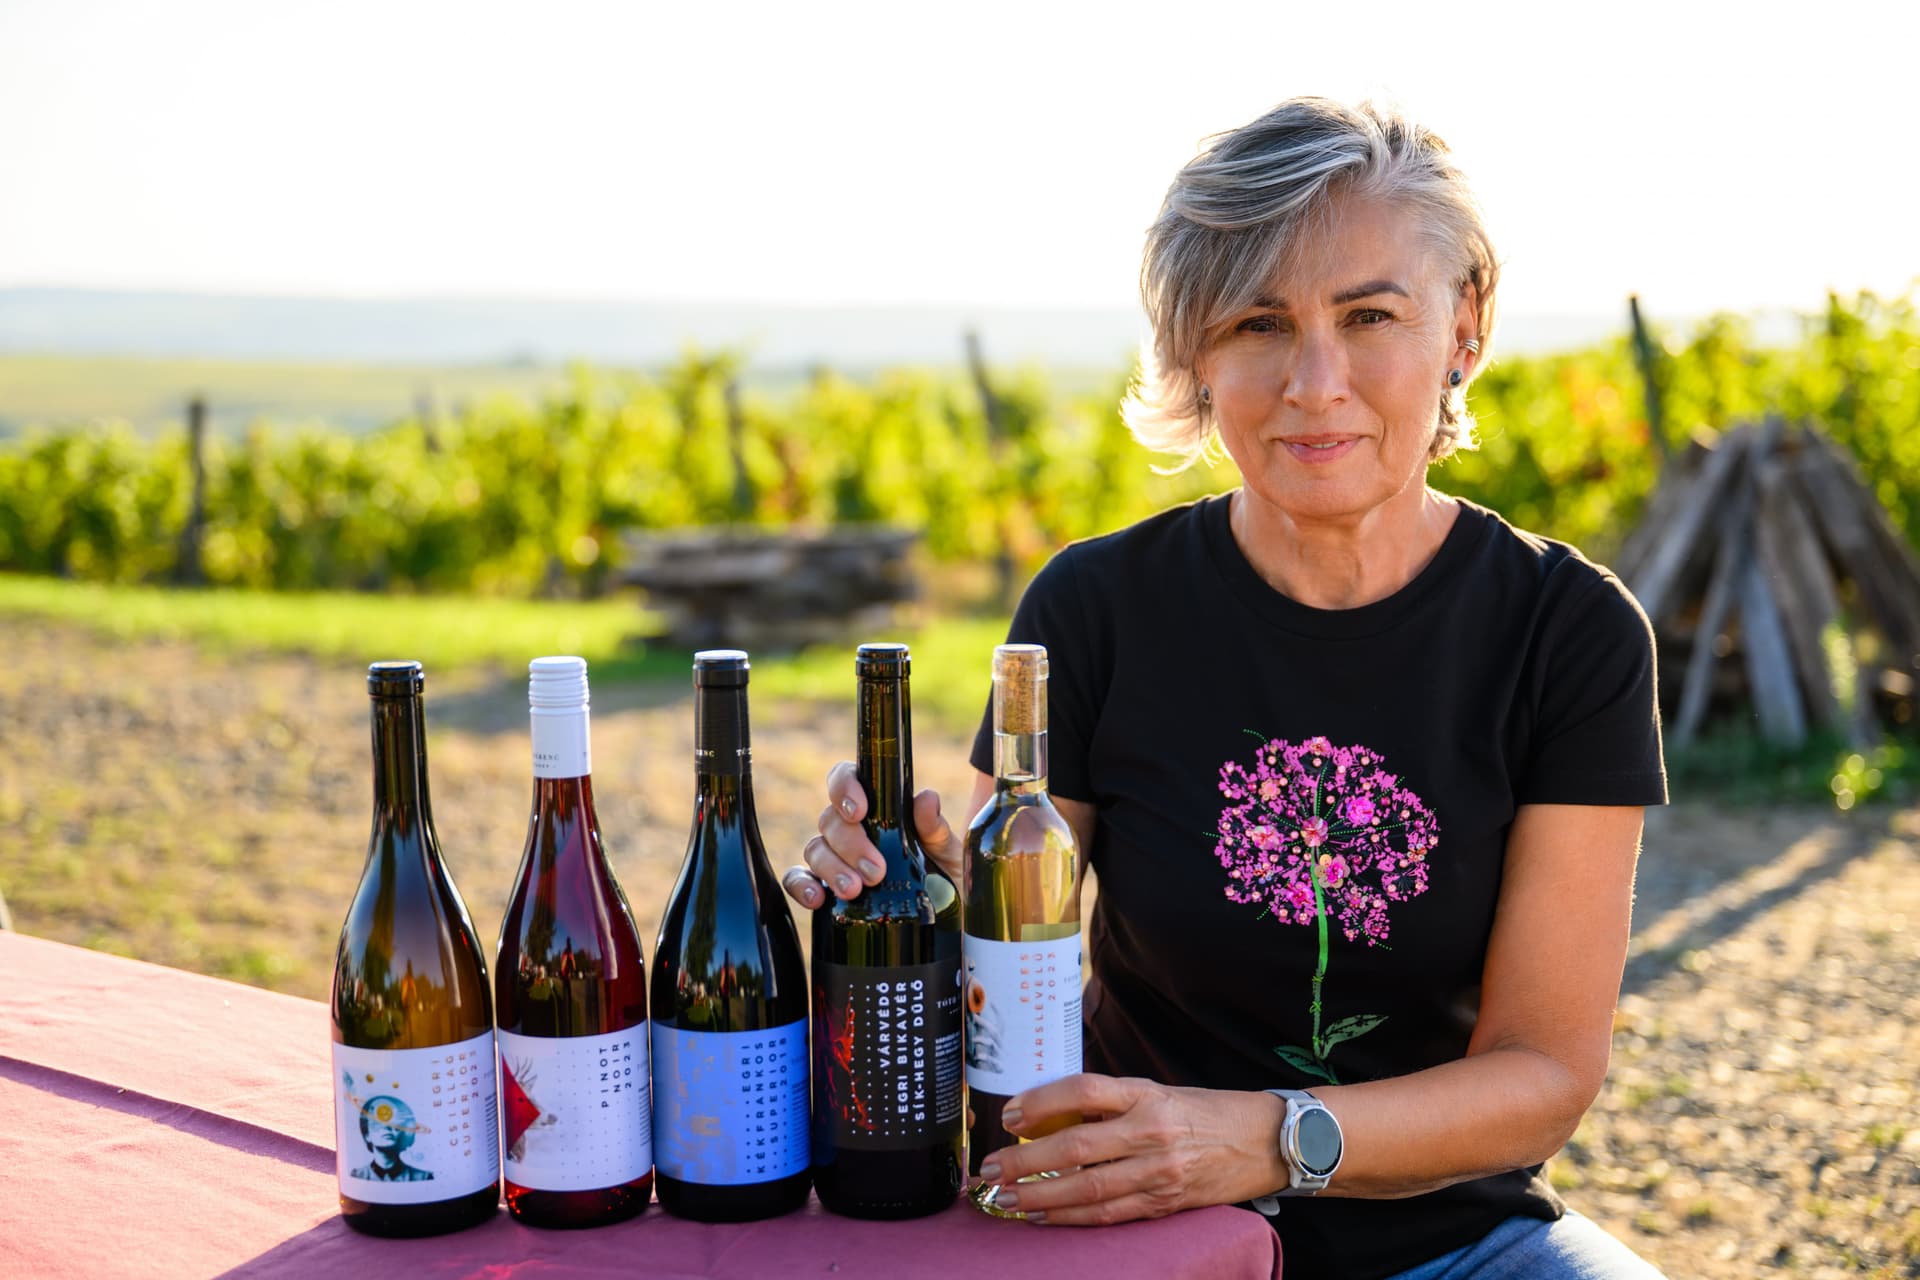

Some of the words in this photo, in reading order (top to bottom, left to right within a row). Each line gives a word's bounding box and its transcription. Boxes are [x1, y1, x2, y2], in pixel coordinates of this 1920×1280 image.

[1019, 953, 1030, 1003] ÉDES
[1047, 951, 1056, 1001] 2023
[876, 982, 891, 1068] VÁRVÉDŐ
[894, 982, 908, 1065] BIKAVÉR
[911, 979, 924, 1027] DŰLŐ
[432, 1060, 442, 1107] EGRI
[599, 1047, 609, 1108] PINOT
[612, 1044, 621, 1093] NOIR
[623, 1041, 632, 1089] 2023
[741, 1045, 751, 1092] EGRI
[779, 1037, 788, 1086] 2018
[913, 1036, 925, 1121] SÍK-HEGY
[445, 1055, 458, 1146] CSILLAG
[459, 1053, 471, 1157] SUPERIOR
[755, 1042, 766, 1174] KÉKFRANKOS
[769, 1039, 779, 1143] SUPERIOR
[897, 1075, 909, 1114] EGRI
